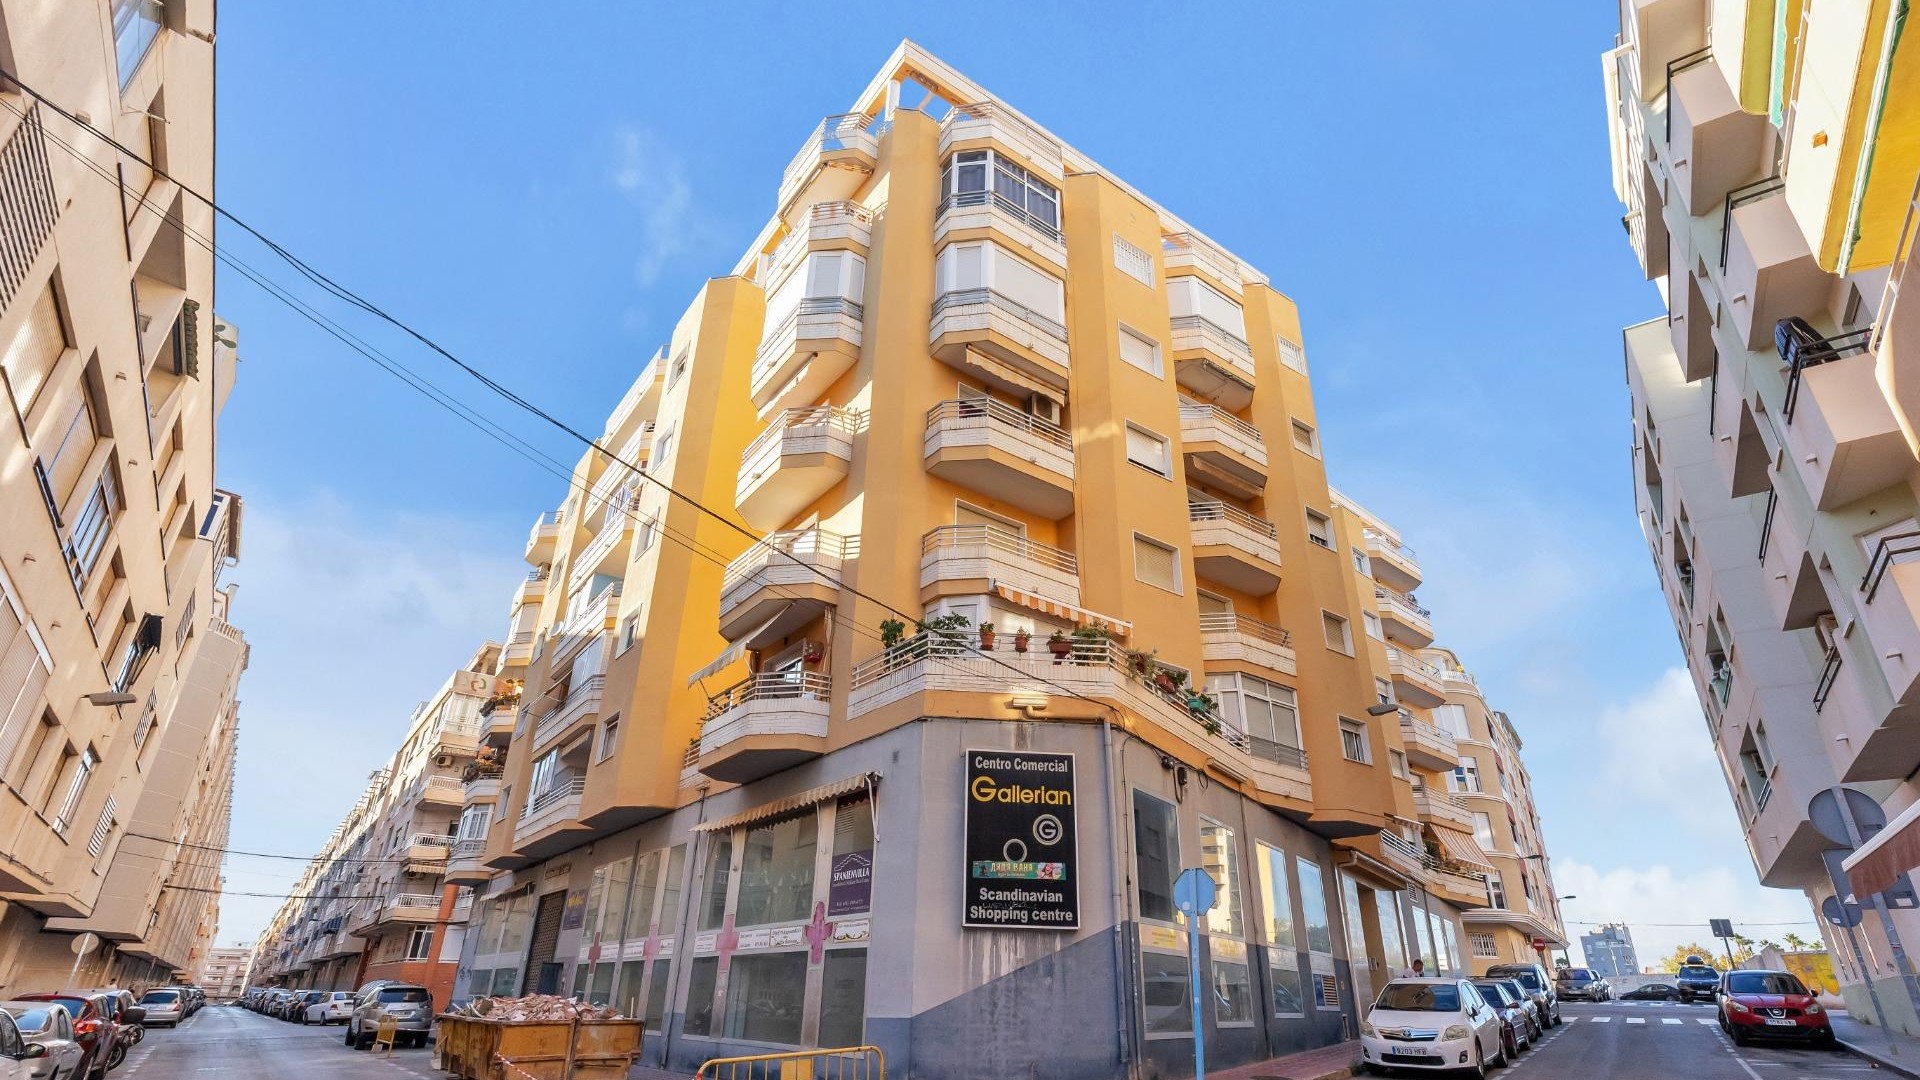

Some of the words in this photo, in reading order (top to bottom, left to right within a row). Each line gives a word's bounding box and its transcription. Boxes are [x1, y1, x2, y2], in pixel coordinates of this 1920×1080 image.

[975, 756, 1011, 770] Centro
[1014, 758, 1068, 773] Comercial
[971, 775, 1072, 806] Gallerian
[833, 867, 870, 882] SPANIENVILLA
[979, 887, 1063, 903] Scandinavian
[970, 905, 1028, 923] Shopping
[1031, 908, 1073, 921] centre
